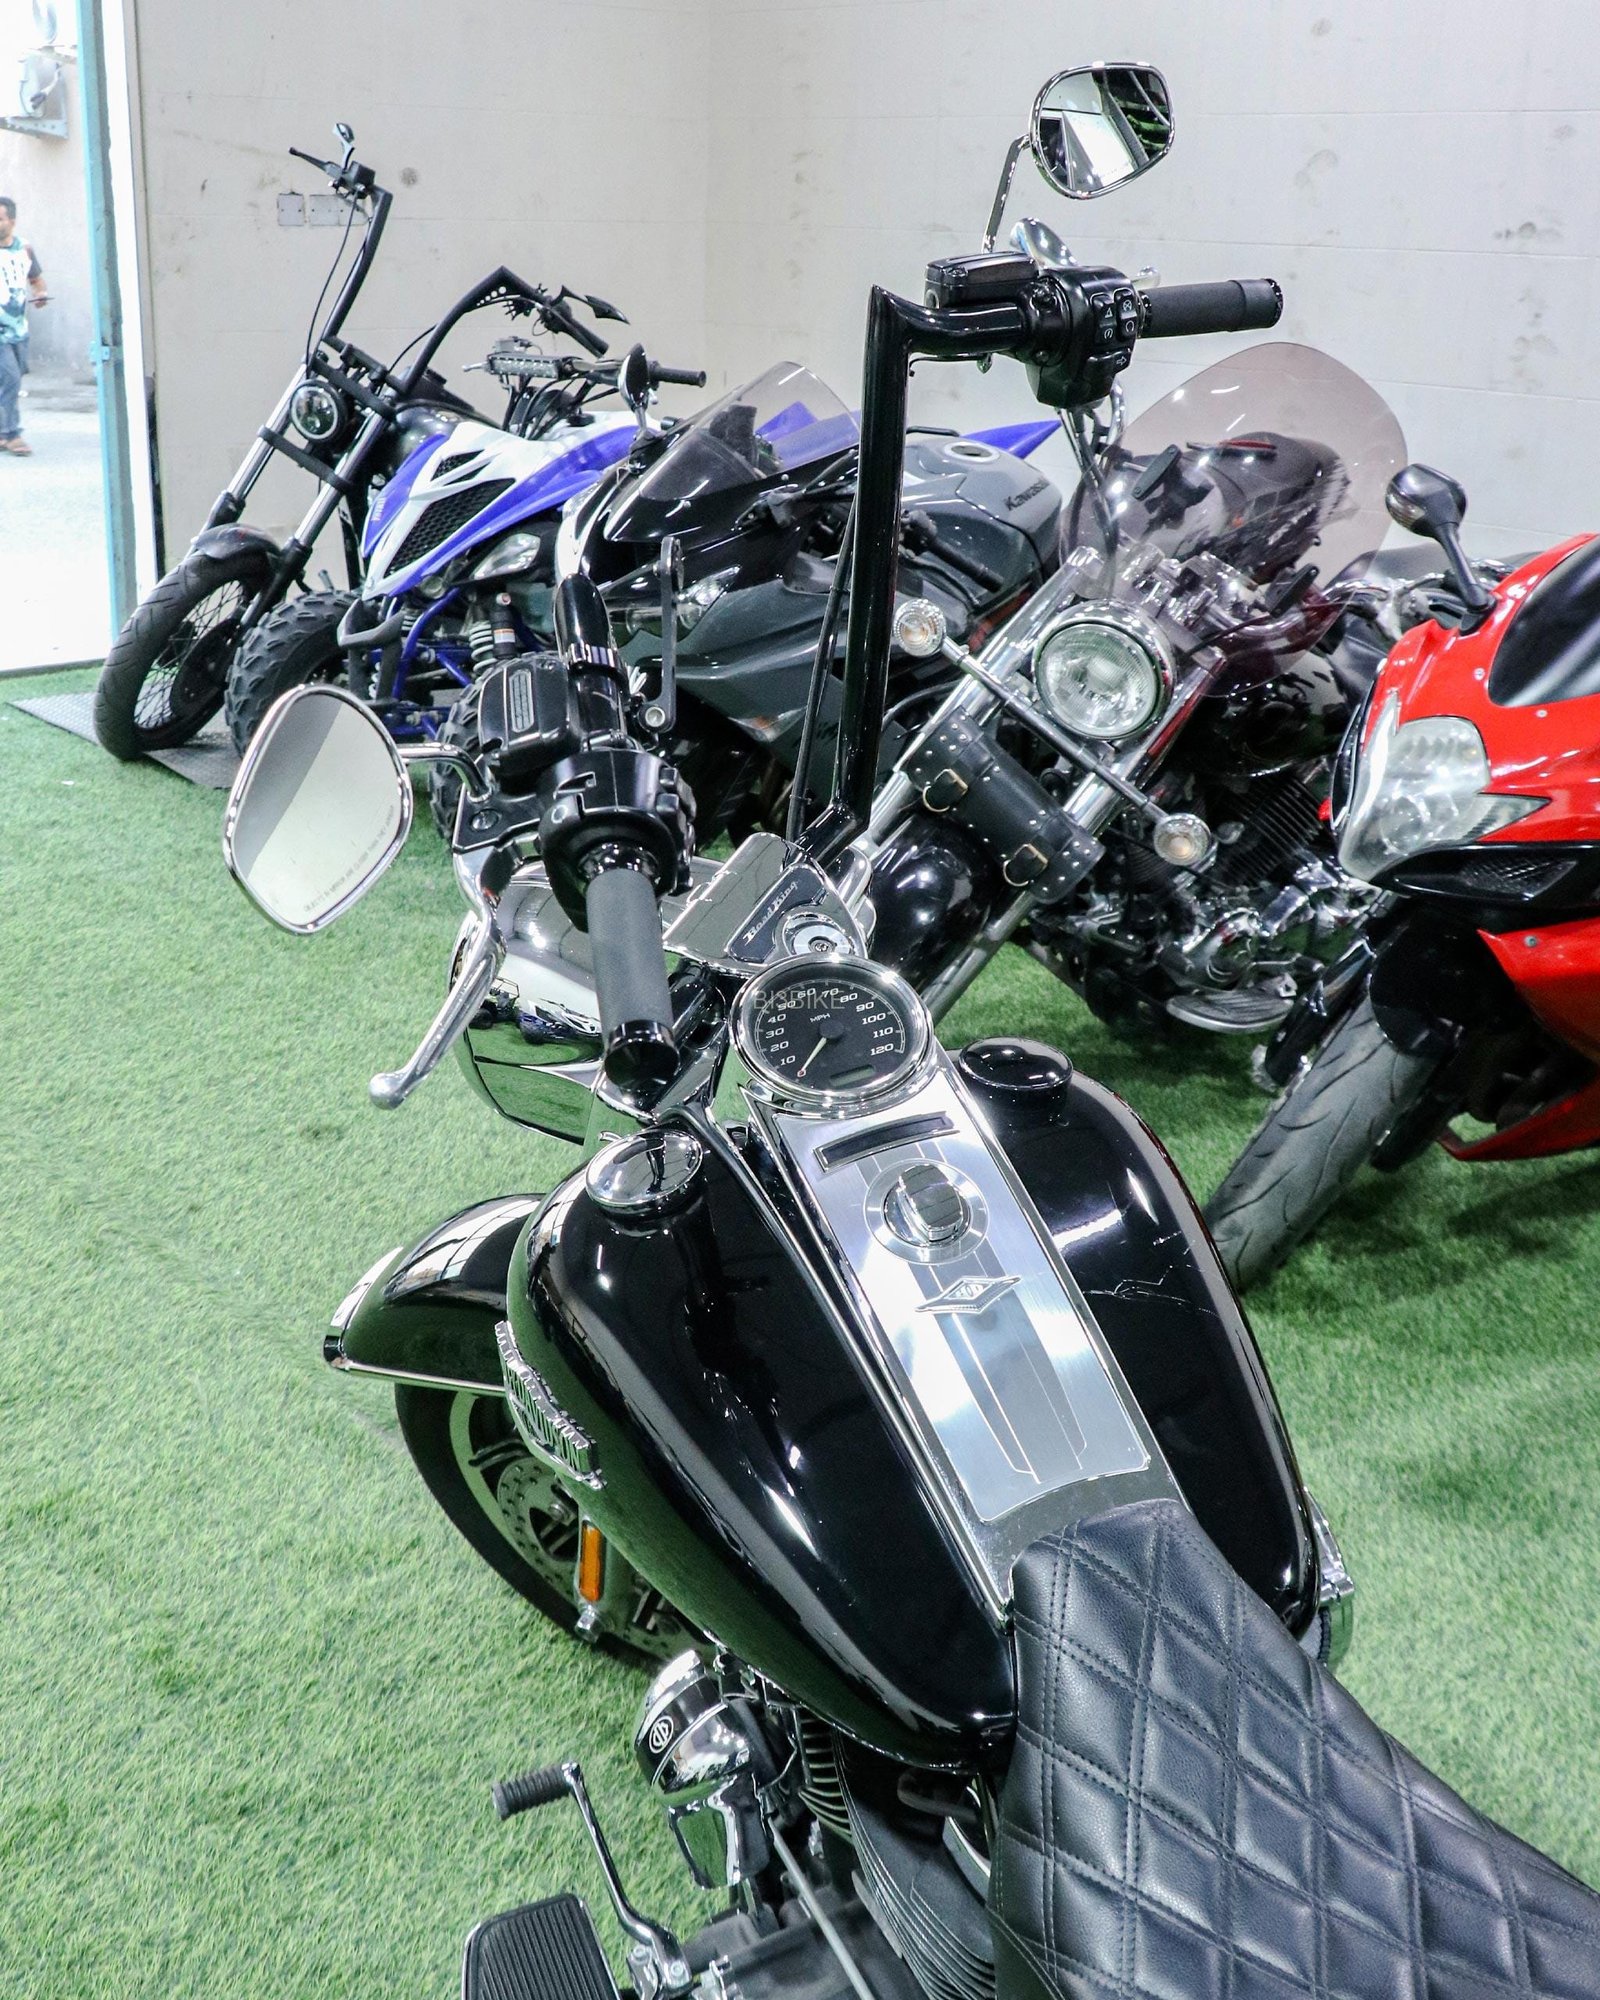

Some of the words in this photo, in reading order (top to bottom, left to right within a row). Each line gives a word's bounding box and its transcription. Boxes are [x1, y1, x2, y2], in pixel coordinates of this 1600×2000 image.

[797, 987, 816, 999] 60
[822, 987, 839, 998] 70
[840, 992, 858, 1003] 80
[777, 1000, 796, 1011] 50
[855, 1001, 874, 1012] 90
[767, 1013, 787, 1024] 40
[809, 1012, 831, 1023] MPH
[861, 1012, 886, 1025] 100
[765, 1027, 785, 1039] 30
[872, 1026, 894, 1039] 110
[770, 1040, 789, 1052] 20
[870, 1043, 894, 1056] 120
[780, 1055, 796, 1066] 10
